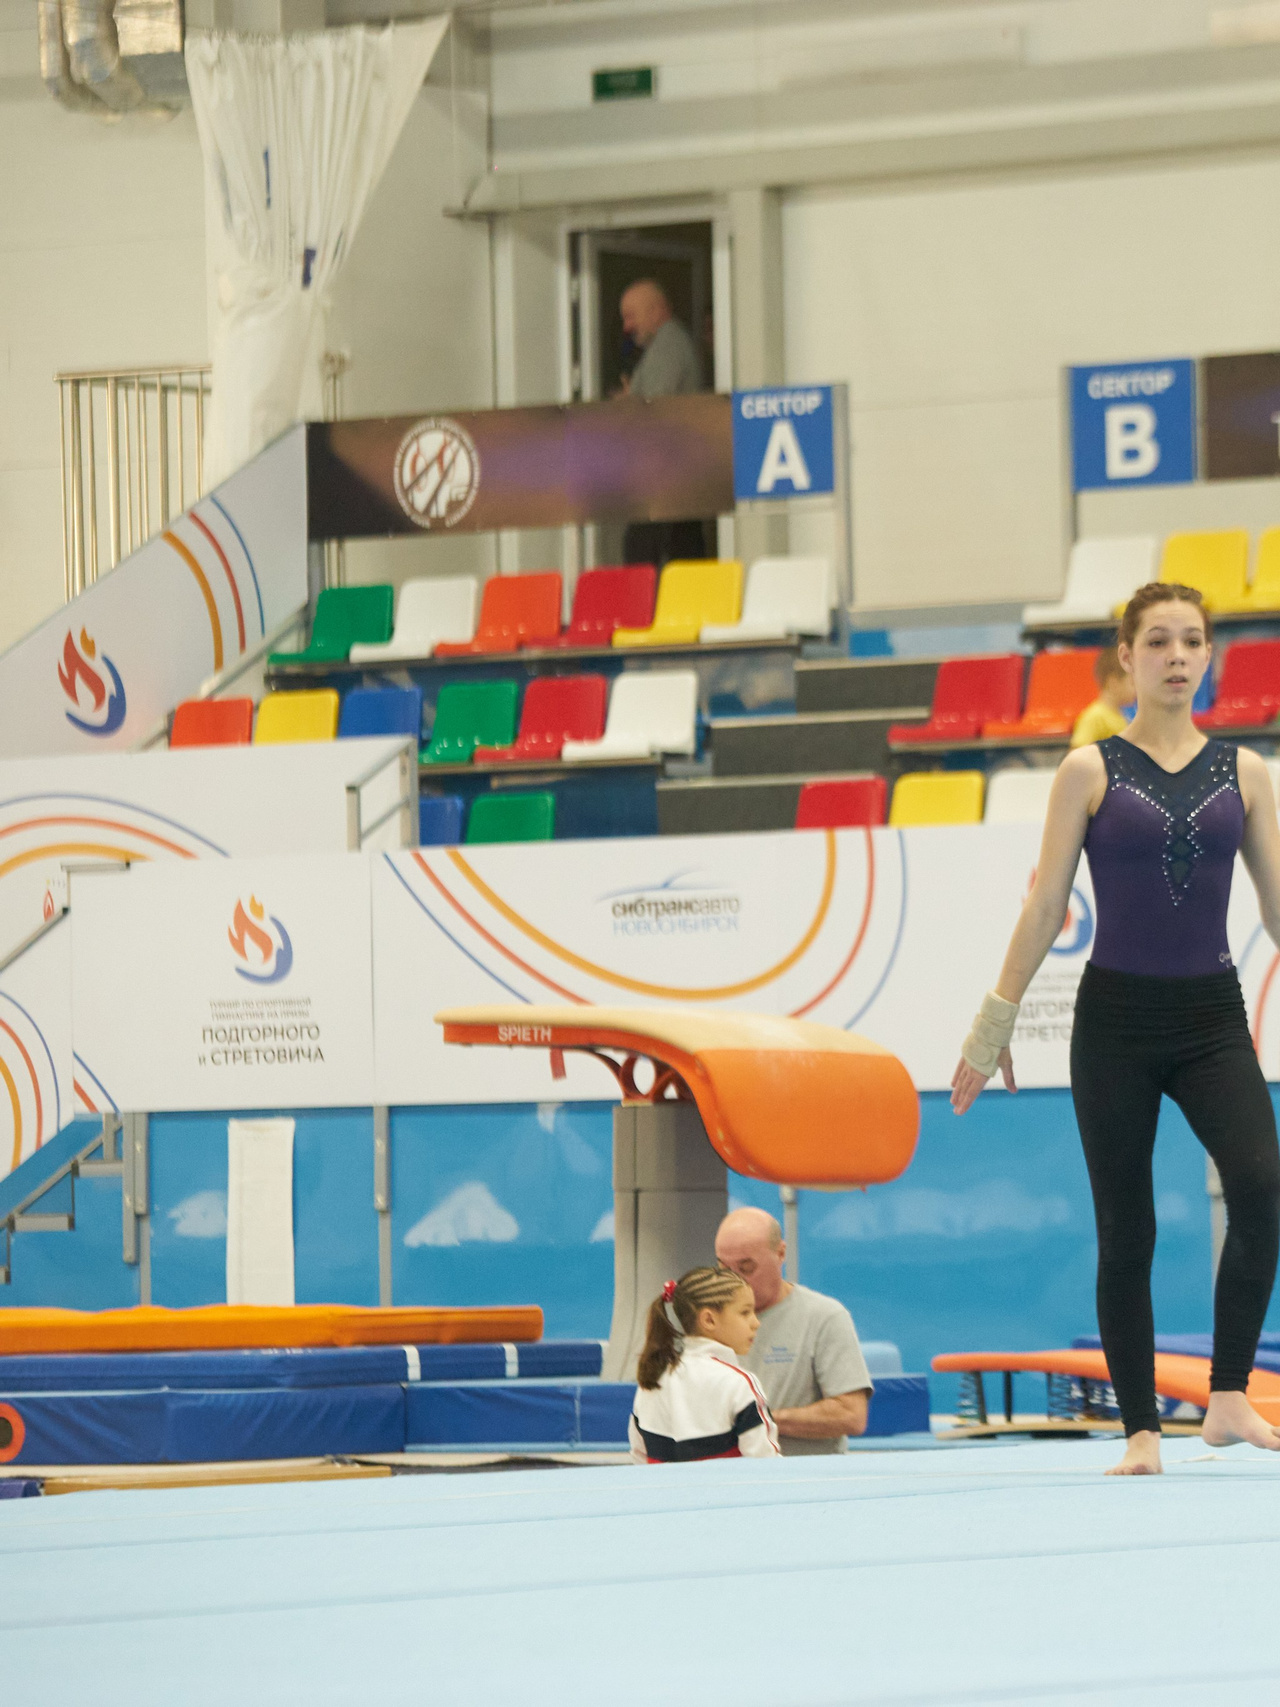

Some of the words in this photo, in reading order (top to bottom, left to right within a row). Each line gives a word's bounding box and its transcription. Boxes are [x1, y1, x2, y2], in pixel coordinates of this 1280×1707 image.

[1087, 368, 1176, 400] СЕКТОР
[741, 390, 823, 419] СЕКТОР
[202, 1023, 321, 1045] ПОДГОРНОГО
[498, 1023, 552, 1042] SPIETH
[211, 1046, 325, 1067] СТРЕТОВИЧА
